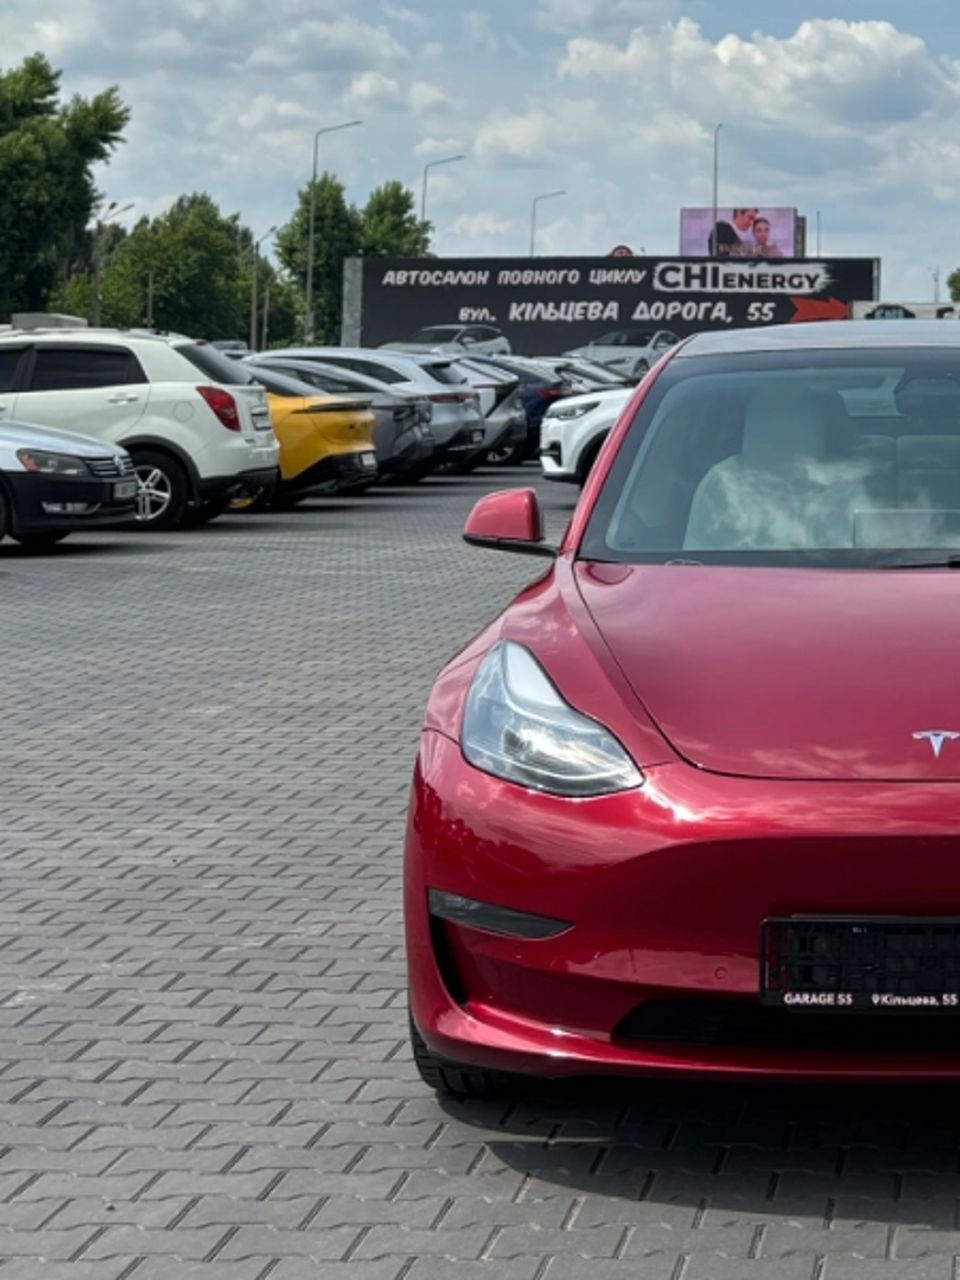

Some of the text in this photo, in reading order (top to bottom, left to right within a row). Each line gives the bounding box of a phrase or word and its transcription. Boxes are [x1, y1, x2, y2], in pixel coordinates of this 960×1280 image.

[382, 270, 490, 286] АВТОСАЛОН
[497, 269, 581, 285] ПОВНОГО
[588, 269, 647, 286] ЦИКЛУ
[508, 300, 620, 323] КІЛЬЦЕВА
[631, 300, 734, 324] ДОРОГА,
[746, 301, 777, 321] 55
[783, 991, 853, 1006] GARAGE 55
[942, 993, 959, 1006] 55
